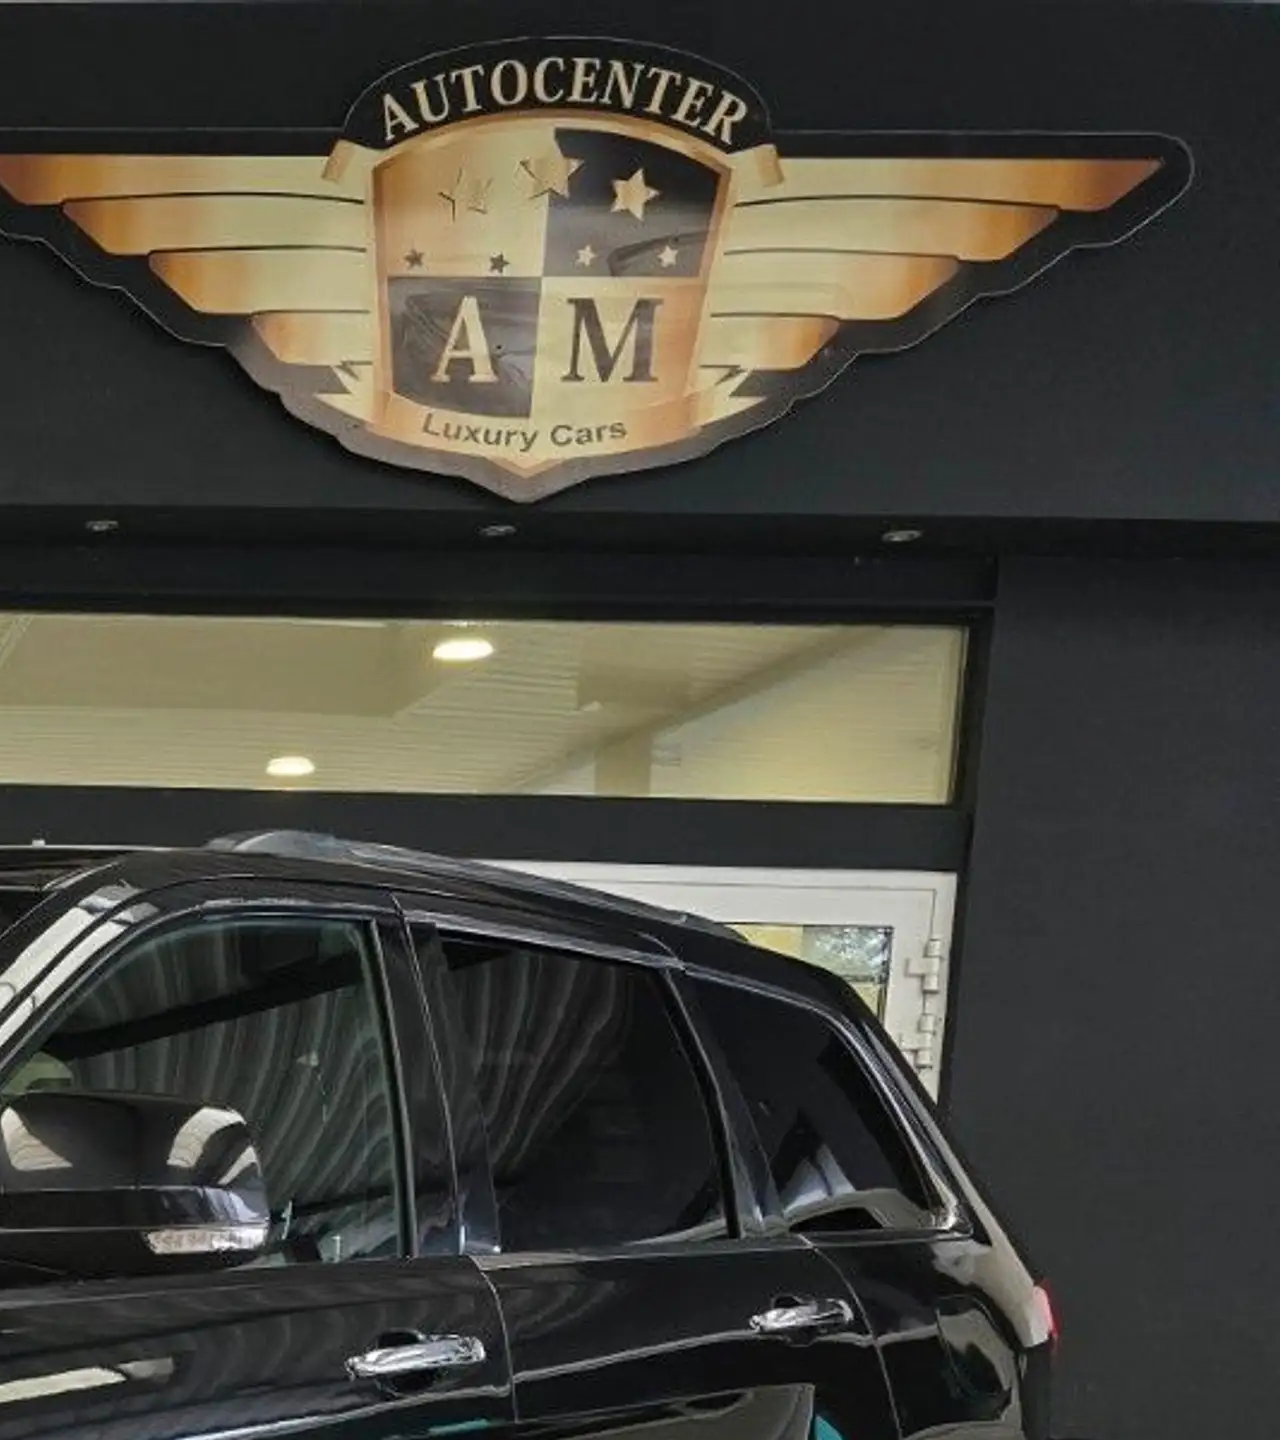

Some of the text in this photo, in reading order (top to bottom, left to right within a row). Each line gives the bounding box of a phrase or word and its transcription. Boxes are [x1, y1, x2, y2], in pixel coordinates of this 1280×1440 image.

[381, 57, 748, 146] AUTOCENTER
[430, 295, 664, 383] A M
[422, 413, 627, 452] Luxury Cars
